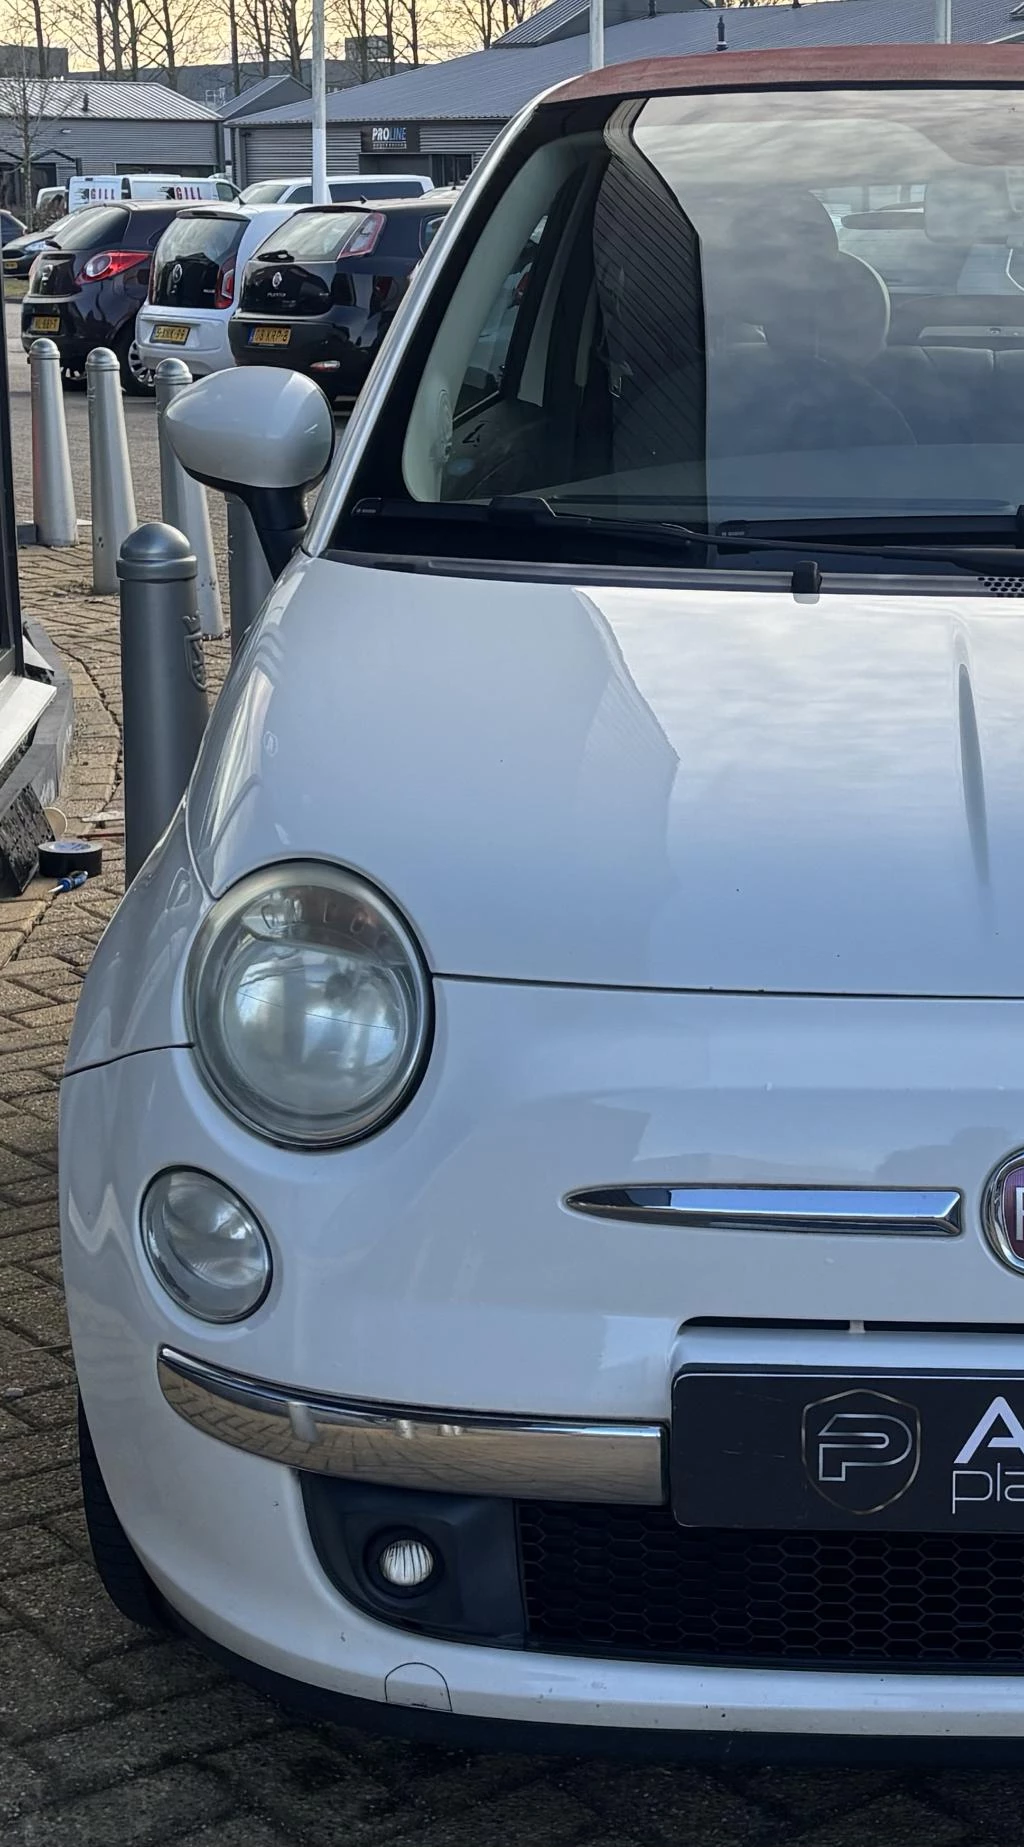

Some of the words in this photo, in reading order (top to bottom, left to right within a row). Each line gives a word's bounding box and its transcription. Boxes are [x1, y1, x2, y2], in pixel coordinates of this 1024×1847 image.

[372, 127, 407, 141] PROLINE
[90, 187, 115, 200] GILL
[176, 186, 203, 200] GILL
